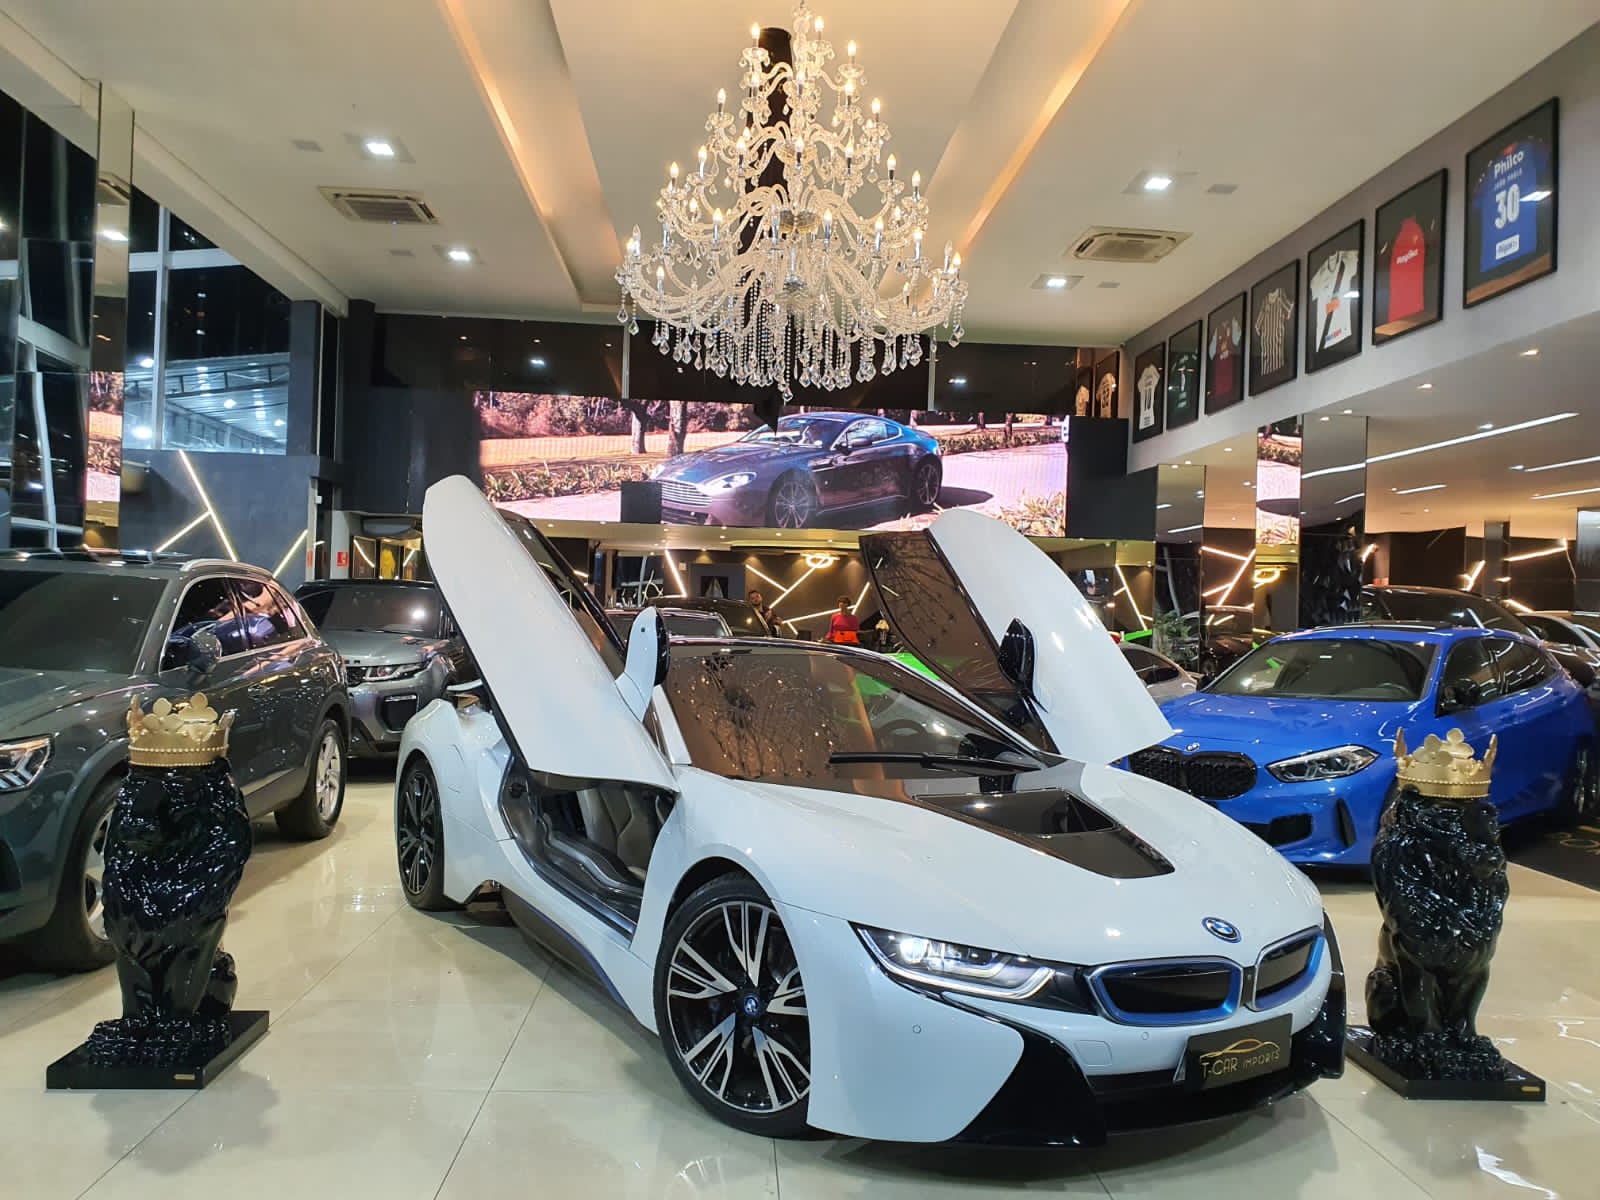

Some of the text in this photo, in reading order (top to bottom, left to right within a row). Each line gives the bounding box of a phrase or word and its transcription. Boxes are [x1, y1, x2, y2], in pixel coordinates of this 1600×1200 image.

[1494, 151, 1524, 177] Philco
[1495, 184, 1520, 228] 30
[1202, 1057, 1238, 1079] T-CAR
